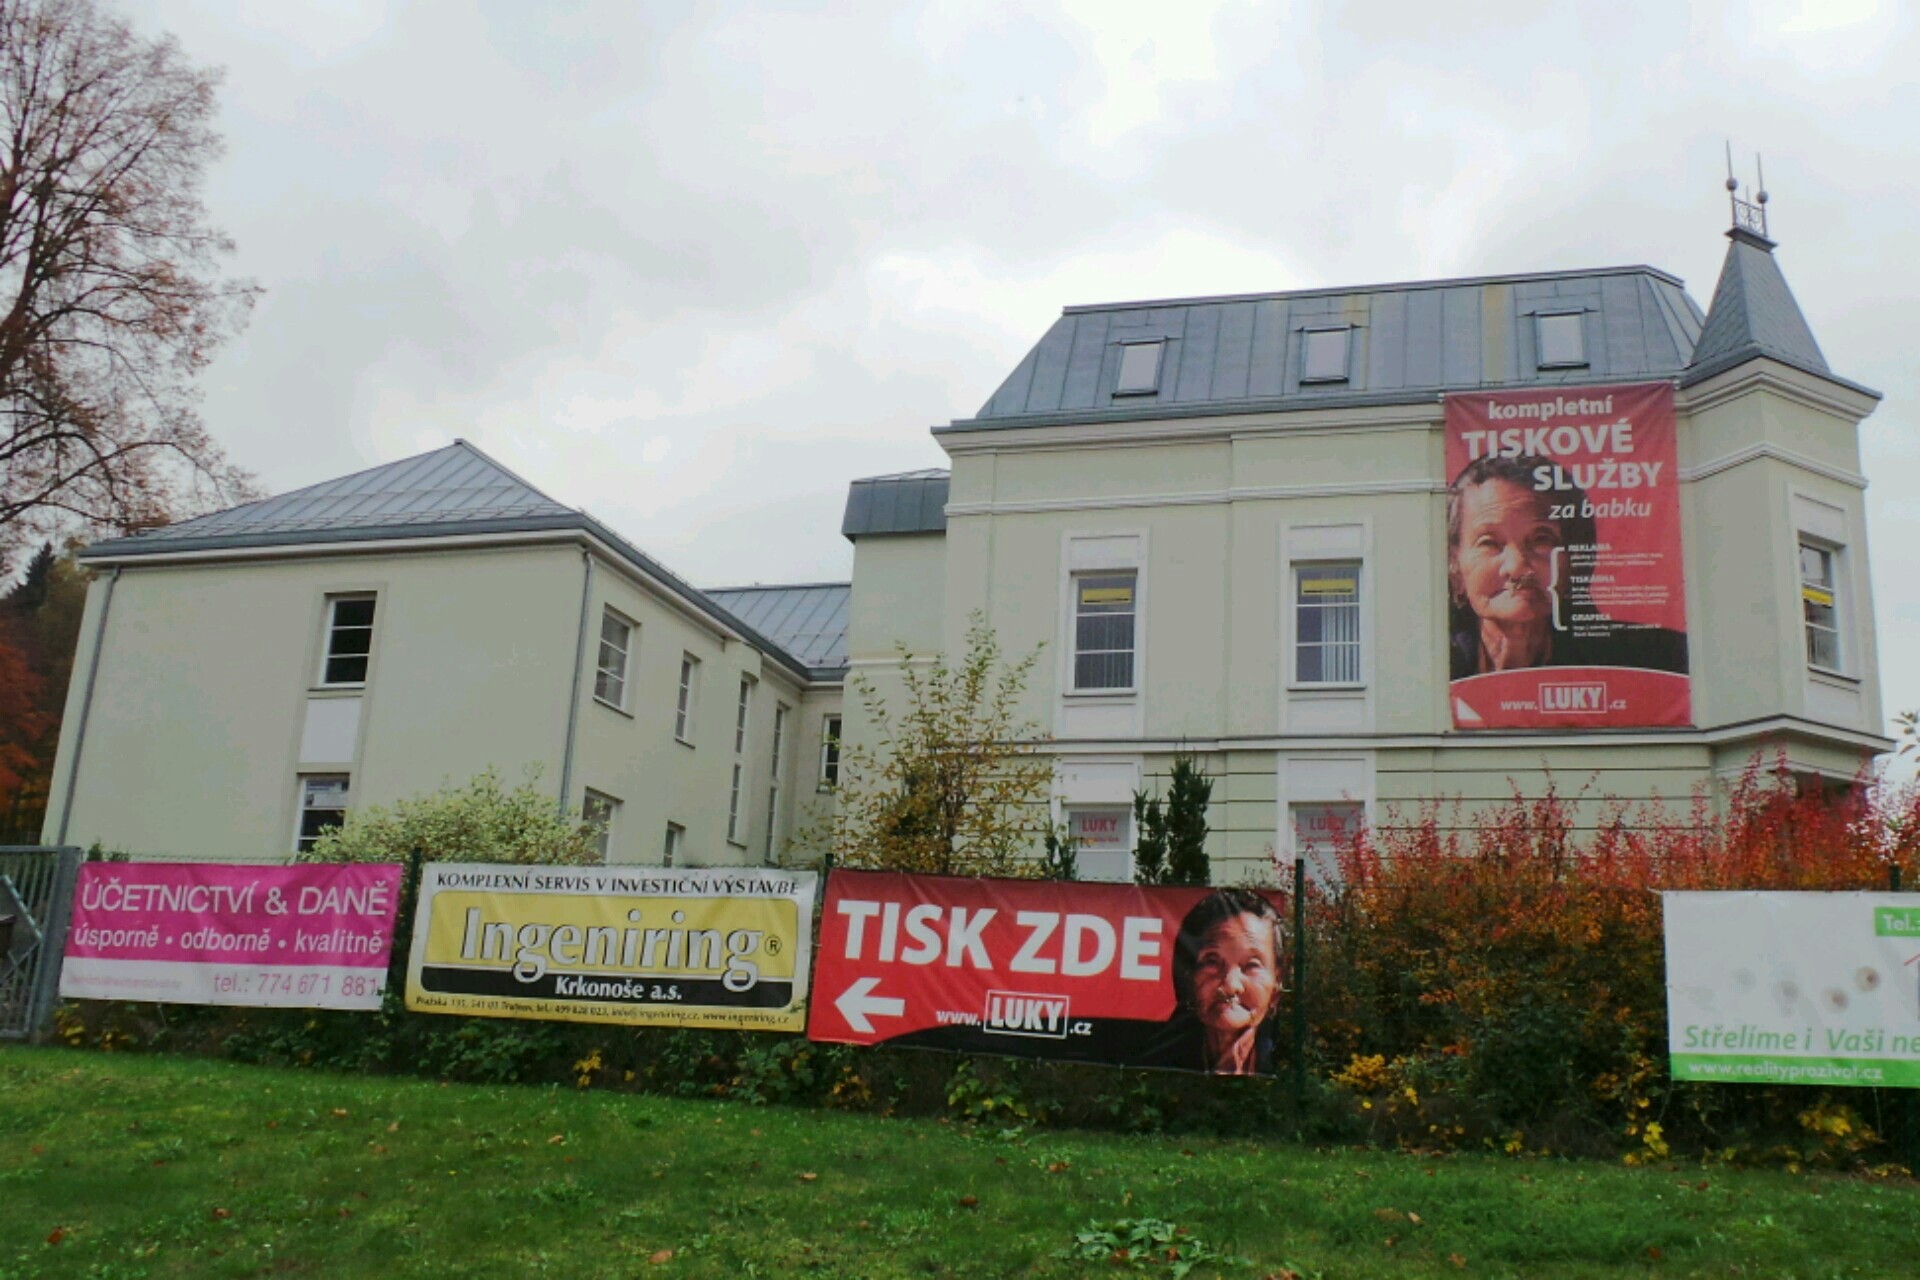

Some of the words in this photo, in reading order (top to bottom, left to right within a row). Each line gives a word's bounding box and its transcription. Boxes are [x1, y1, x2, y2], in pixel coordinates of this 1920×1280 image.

[1488, 395, 1613, 421] kompletní
[1461, 417, 1635, 460] TISKOVÉ
[1532, 458, 1664, 491] SLUŽBY
[1548, 503, 1576, 520] za
[1581, 498, 1653, 518] babku
[437, 868, 533, 890] KOMPLEXNÍ
[535, 875, 590, 891] SERVIS
[596, 878, 607, 891] V
[611, 873, 710, 893] INVESTIČNÍ
[81, 877, 259, 913] ÚČETNICTVÍ
[265, 887, 288, 913] &
[297, 880, 389, 916] DANĚ
[74, 922, 159, 949] úsporně
[180, 927, 270, 951] odborně
[294, 927, 383, 954] kvalitně
[460, 906, 764, 992] Ingeniring
[837, 899, 998, 971] TISK
[1009, 911, 1164, 981] ZDE
[213, 972, 250, 993] tel.:
[257, 973, 292, 993] 774
[299, 974, 330, 995] 671
[555, 974, 644, 1000] Krkonoše
[650, 982, 682, 1001] a.s.
[1684, 1024, 1797, 1050] Střelíme
[1804, 1026, 1813, 1050] i
[1826, 1028, 1885, 1052] Vaši
